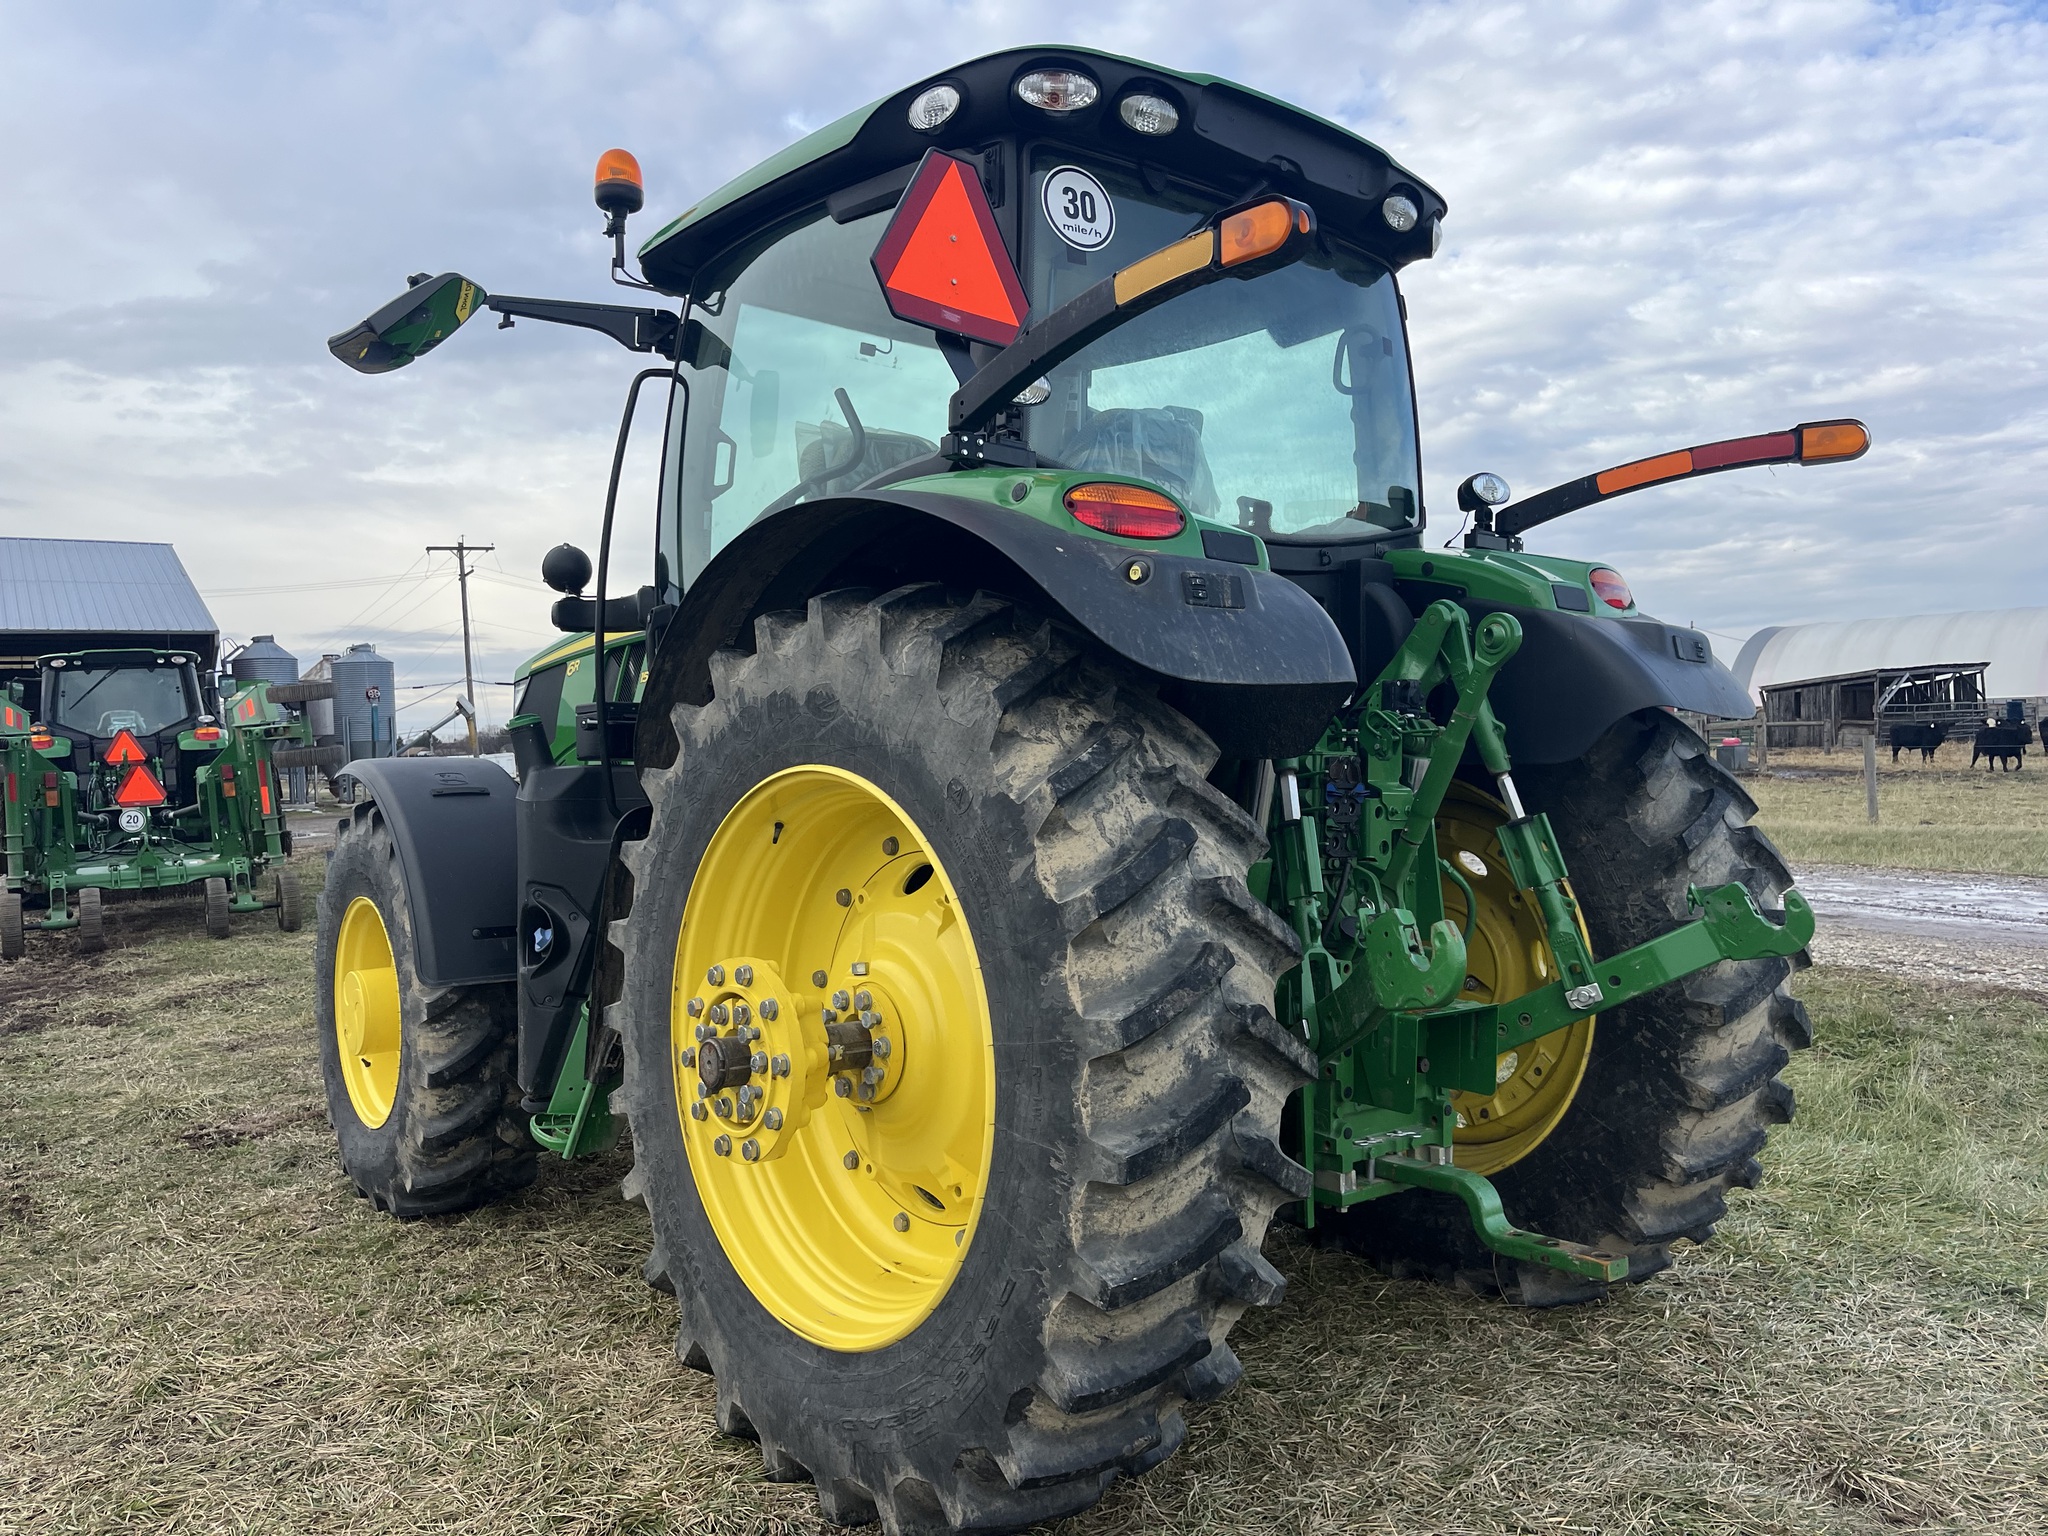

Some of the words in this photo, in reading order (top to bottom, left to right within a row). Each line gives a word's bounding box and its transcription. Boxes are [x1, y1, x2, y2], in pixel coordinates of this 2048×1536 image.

[1062, 186, 1096, 223] 30
[1063, 223, 1102, 238] mile/h
[566, 659, 580, 677] 6R
[126, 814, 139, 824] 20
